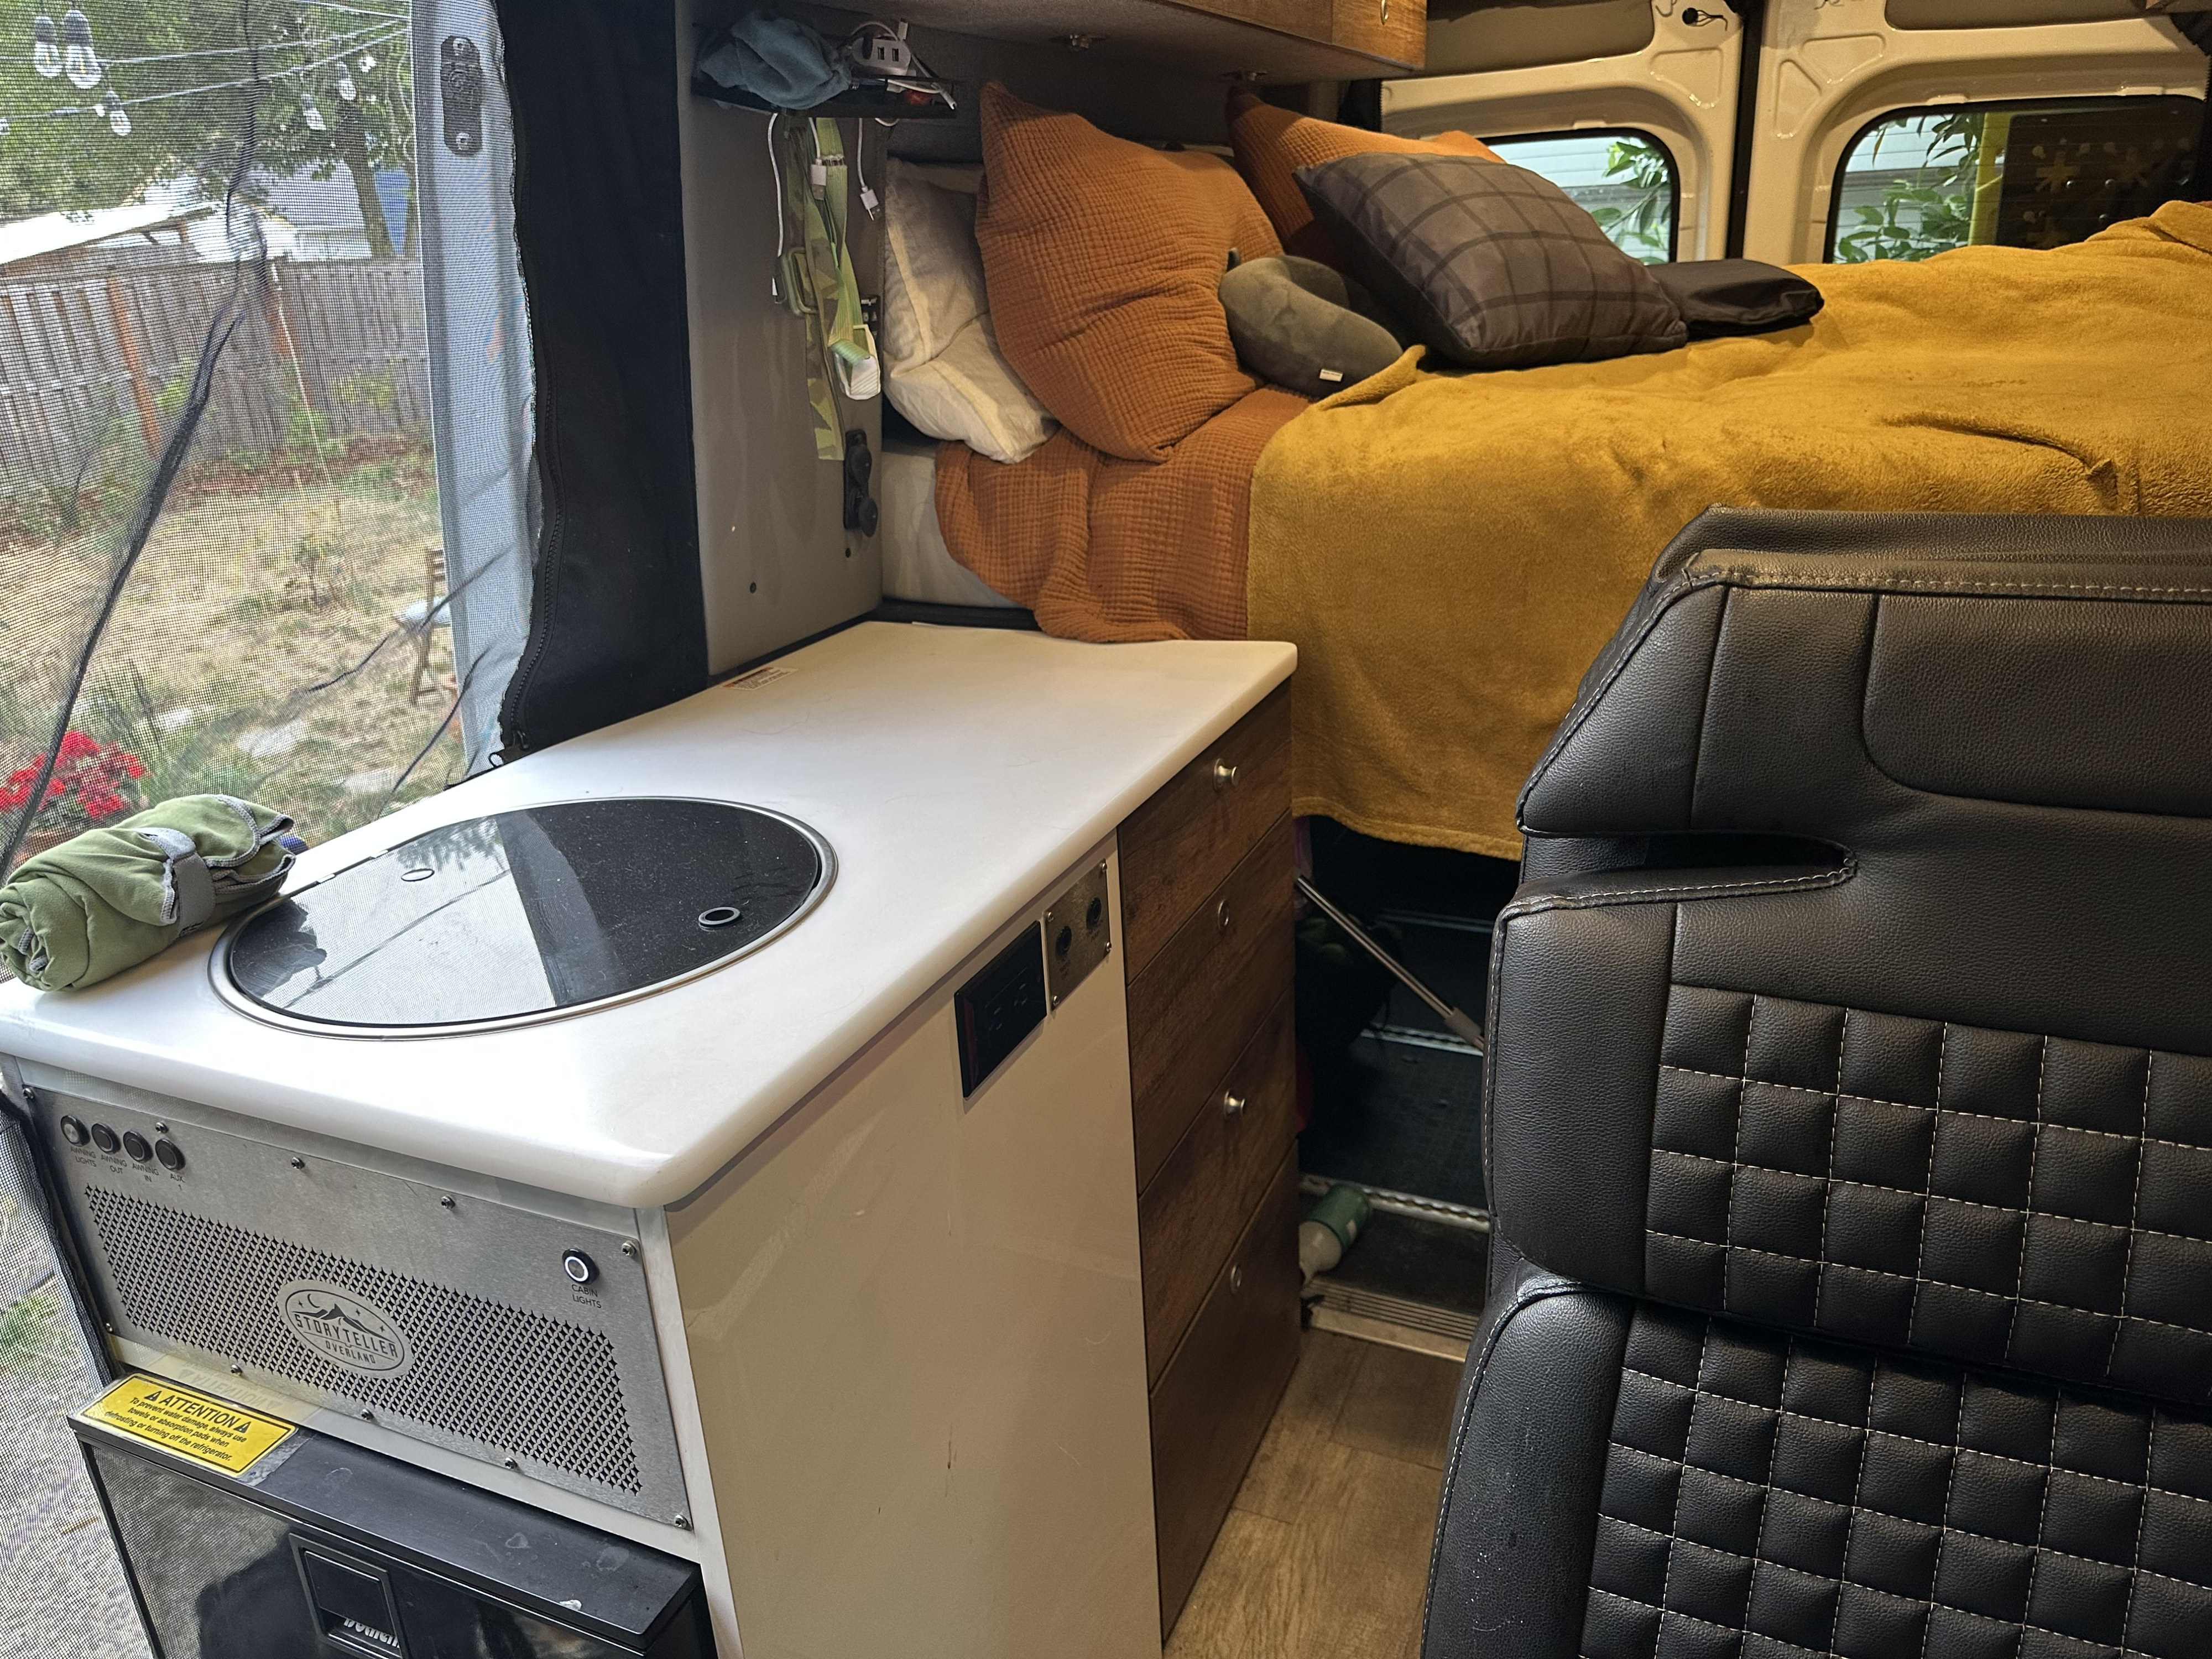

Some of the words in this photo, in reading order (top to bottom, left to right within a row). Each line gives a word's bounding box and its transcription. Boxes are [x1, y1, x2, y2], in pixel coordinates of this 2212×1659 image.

[70, 1146, 96, 1159] AWNING
[75, 1155, 97, 1167] LIGHTS
[101, 1155, 127, 1167] AWNING
[110, 1165, 123, 1174] OUT
[132, 1163, 159, 1176] AWNING
[572, 1284, 598, 1297] CABIN
[572, 1294, 602, 1308] LIGHTS
[294, 1313, 398, 1358] STORYTELLER
[326, 1340, 375, 1364] OVERLAND
[158, 1395, 241, 1428] ATTENTION
[137, 1401, 165, 1413] prevent
[163, 1408, 183, 1420] water
[181, 1416, 208, 1430] damage,
[209, 1426, 233, 1437] always
[128, 1407, 150, 1418] towels
[157, 1418, 193, 1434] absorption
[190, 1431, 211, 1440] pads
[210, 1437, 229, 1447] when
[105, 1411, 138, 1427] defrosting
[145, 1425, 170, 1439] turning
[179, 1437, 191, 1446] the
[190, 1442, 232, 1461] refrigerator.
